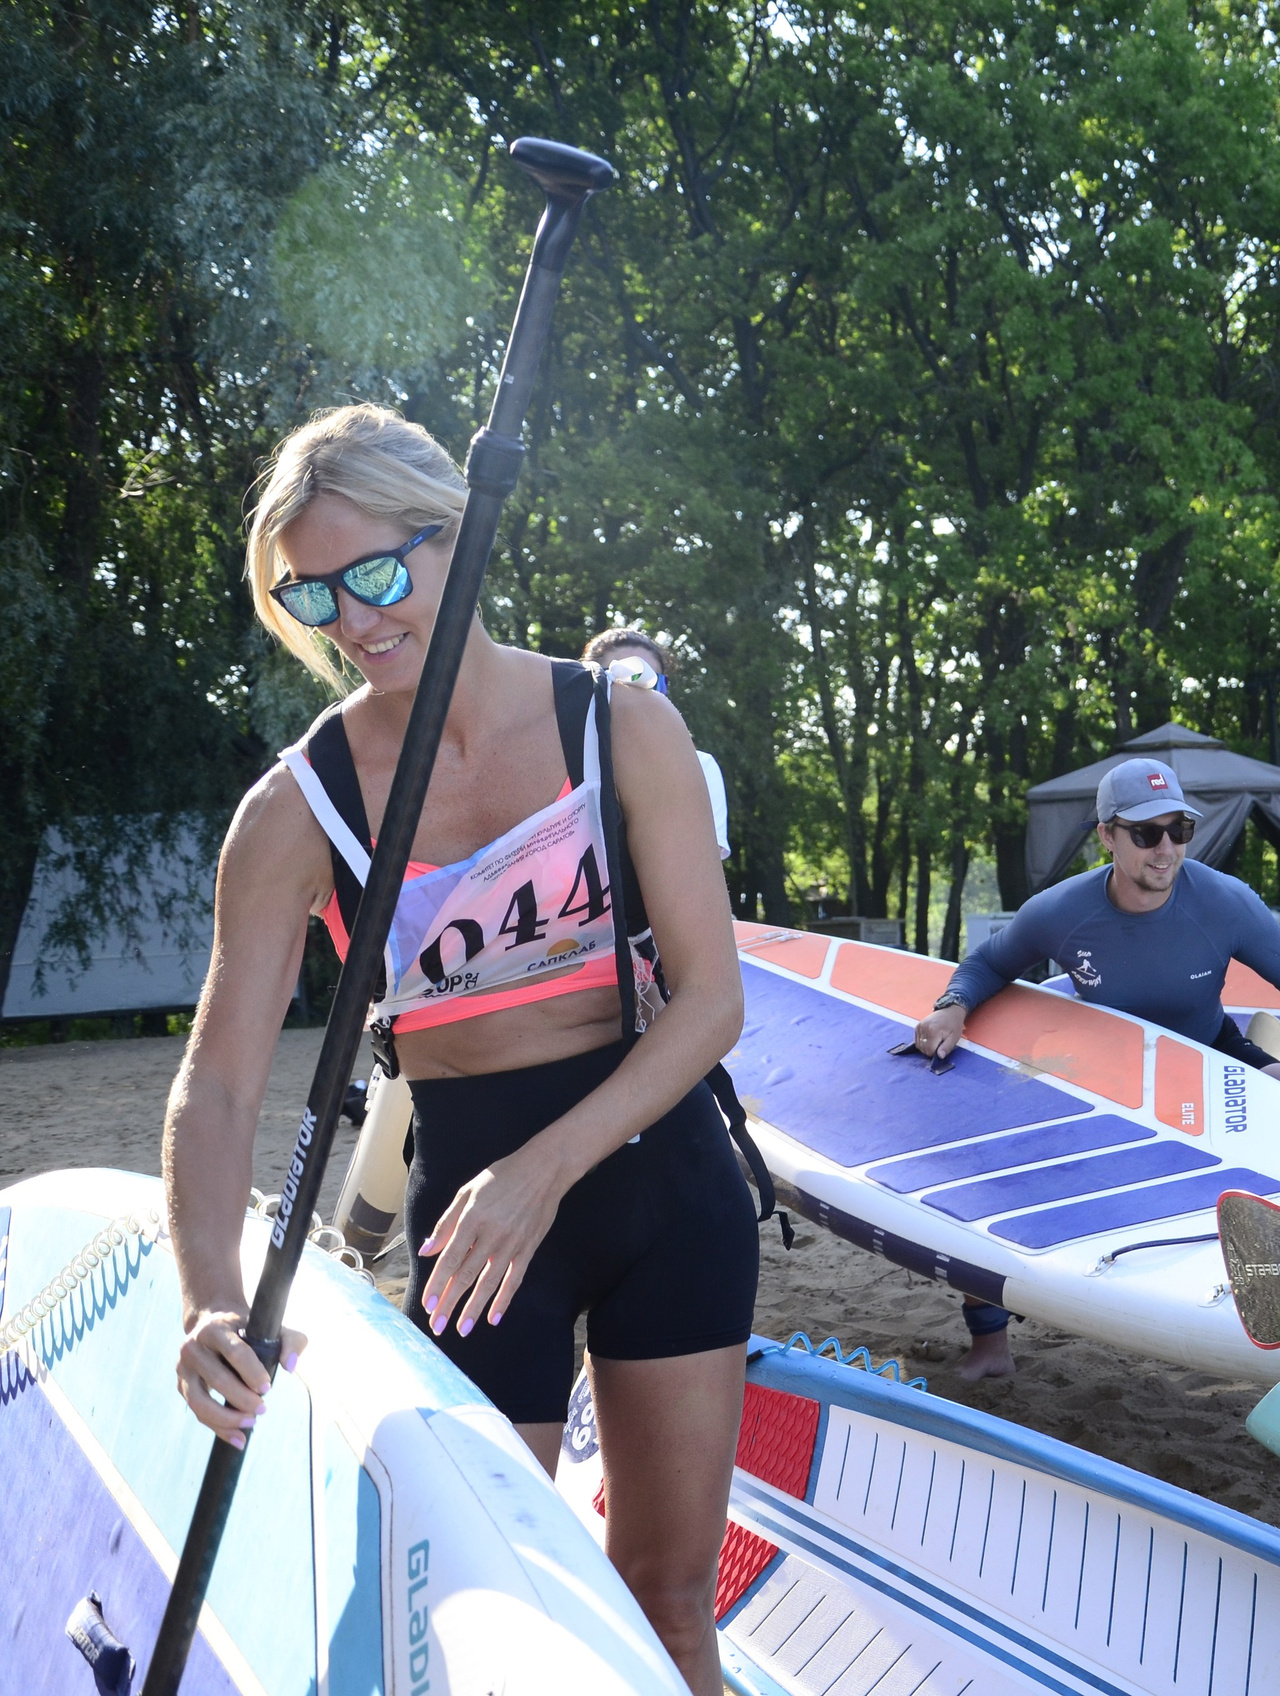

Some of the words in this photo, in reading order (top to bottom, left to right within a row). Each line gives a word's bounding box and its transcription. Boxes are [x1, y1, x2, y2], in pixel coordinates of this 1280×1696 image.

[1151, 773, 1166, 786] red
[420, 843, 612, 985] 044
[527, 940, 597, 973] САПКЛАБ
[1190, 970, 1212, 980] OLAIAN
[1181, 1102, 1195, 1125] ELITE
[1223, 1065, 1247, 1134] GLADIATOR
[271, 1106, 317, 1249] GLADIATOR
